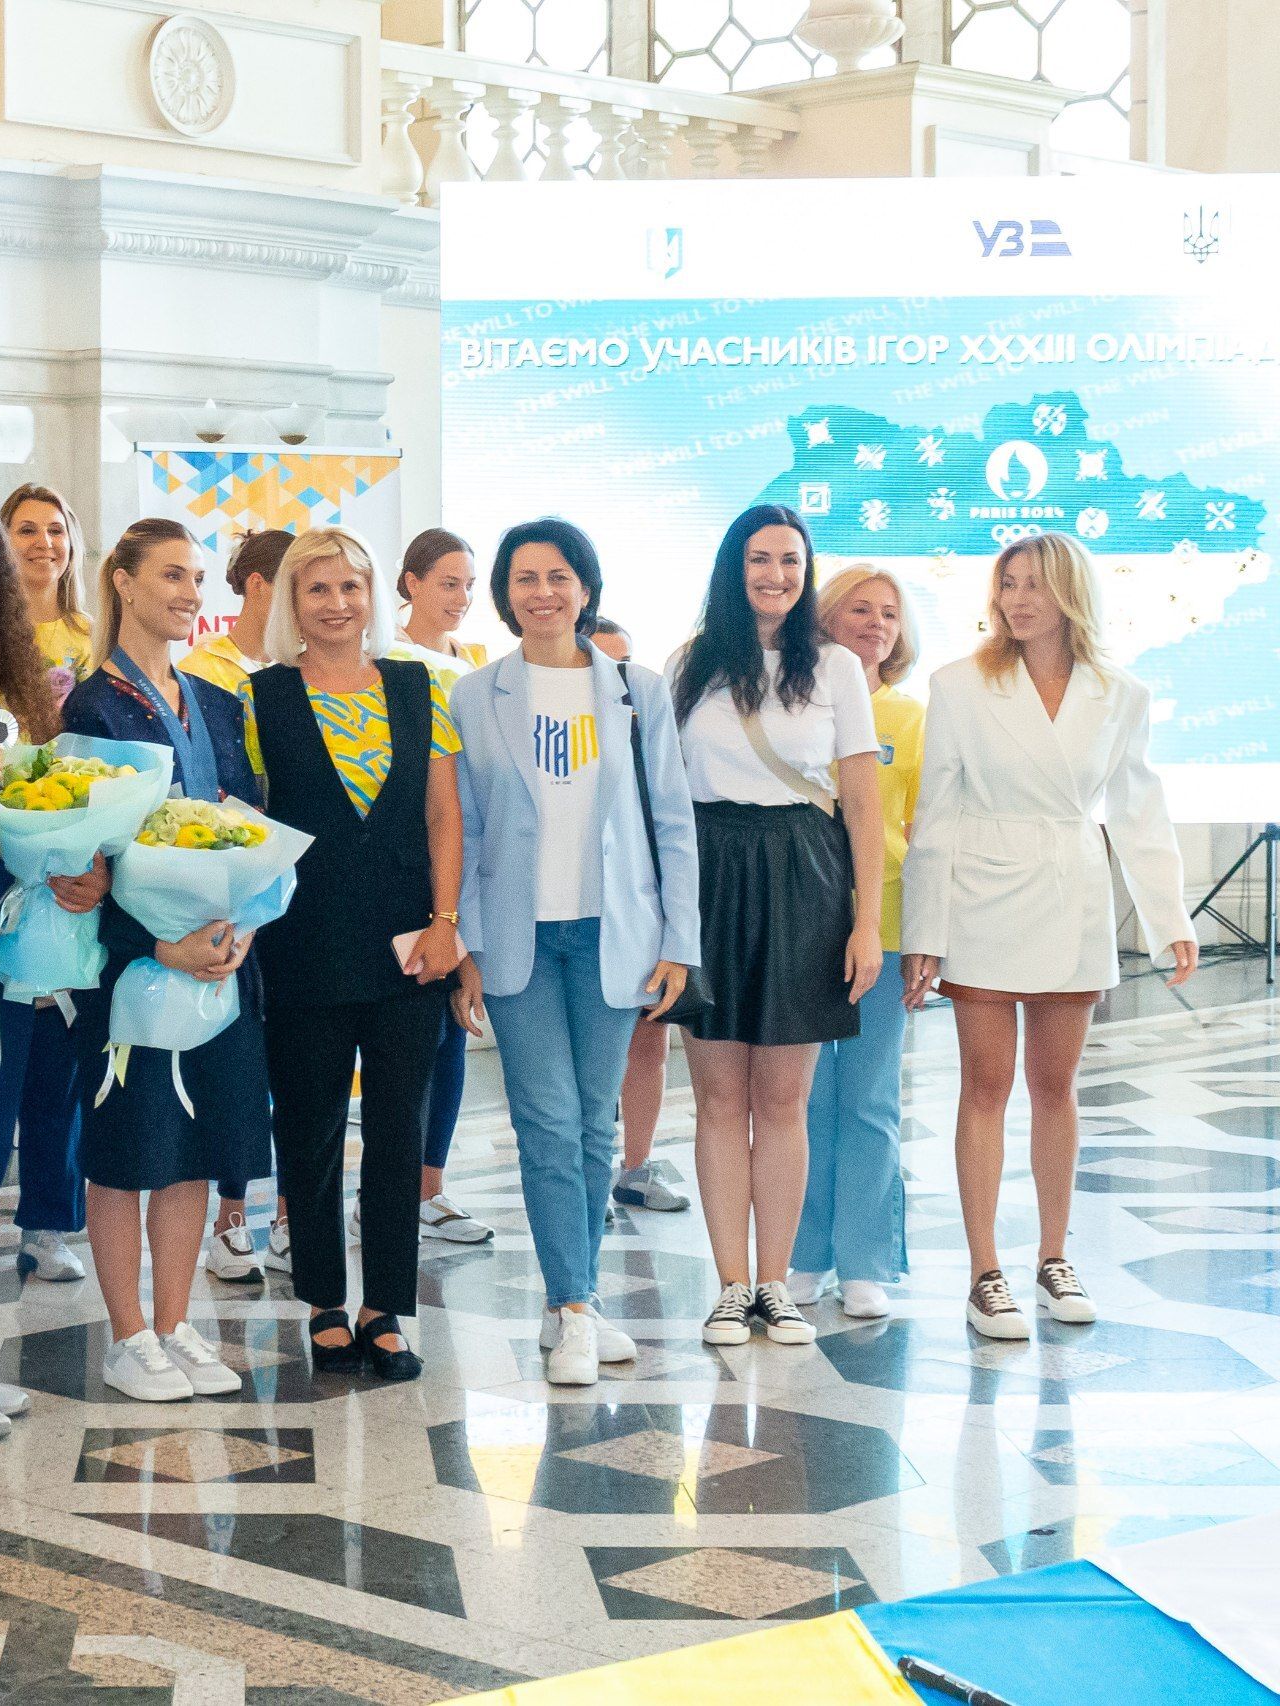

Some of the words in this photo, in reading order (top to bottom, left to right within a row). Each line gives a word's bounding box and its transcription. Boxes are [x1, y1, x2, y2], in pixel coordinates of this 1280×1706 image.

[466, 313, 519, 337] WILL
[522, 302, 554, 322] TO
[652, 308, 708, 332] WILL
[460, 336, 629, 369] ВІТАЄМО
[637, 334, 858, 373] УЧАСНИКІВ
[867, 333, 950, 365] ІГОР
[559, 378, 616, 402] WILL
[709, 430, 743, 451] TO
[969, 505, 1018, 519] PARIS
[1020, 505, 1065, 519] 2024
